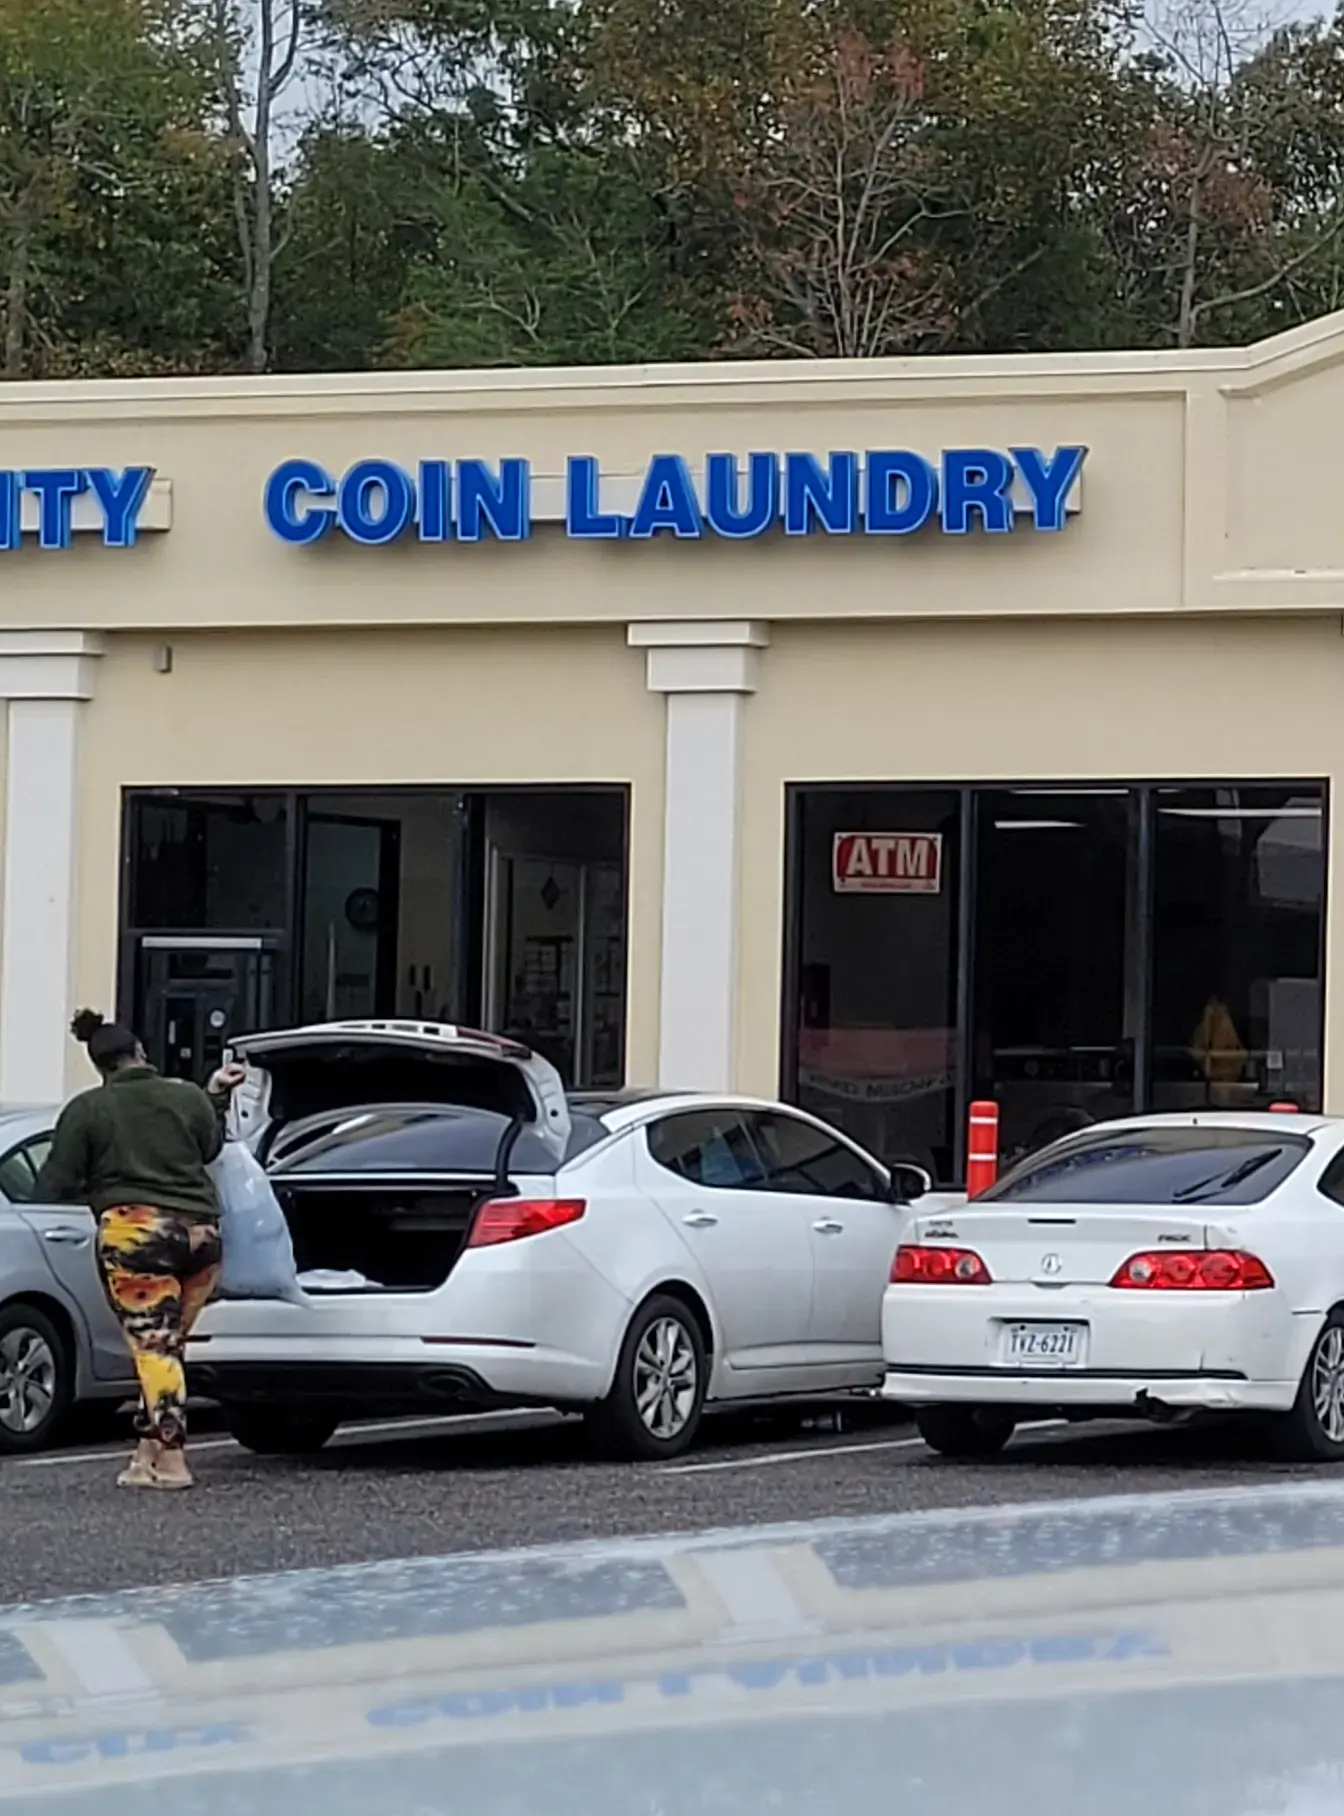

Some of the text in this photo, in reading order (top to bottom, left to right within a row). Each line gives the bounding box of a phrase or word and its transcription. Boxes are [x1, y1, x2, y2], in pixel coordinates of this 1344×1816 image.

[264, 457, 531, 545] COIN
[566, 446, 1089, 540] LAUNDRY
[846, 838, 929, 877] ATM
